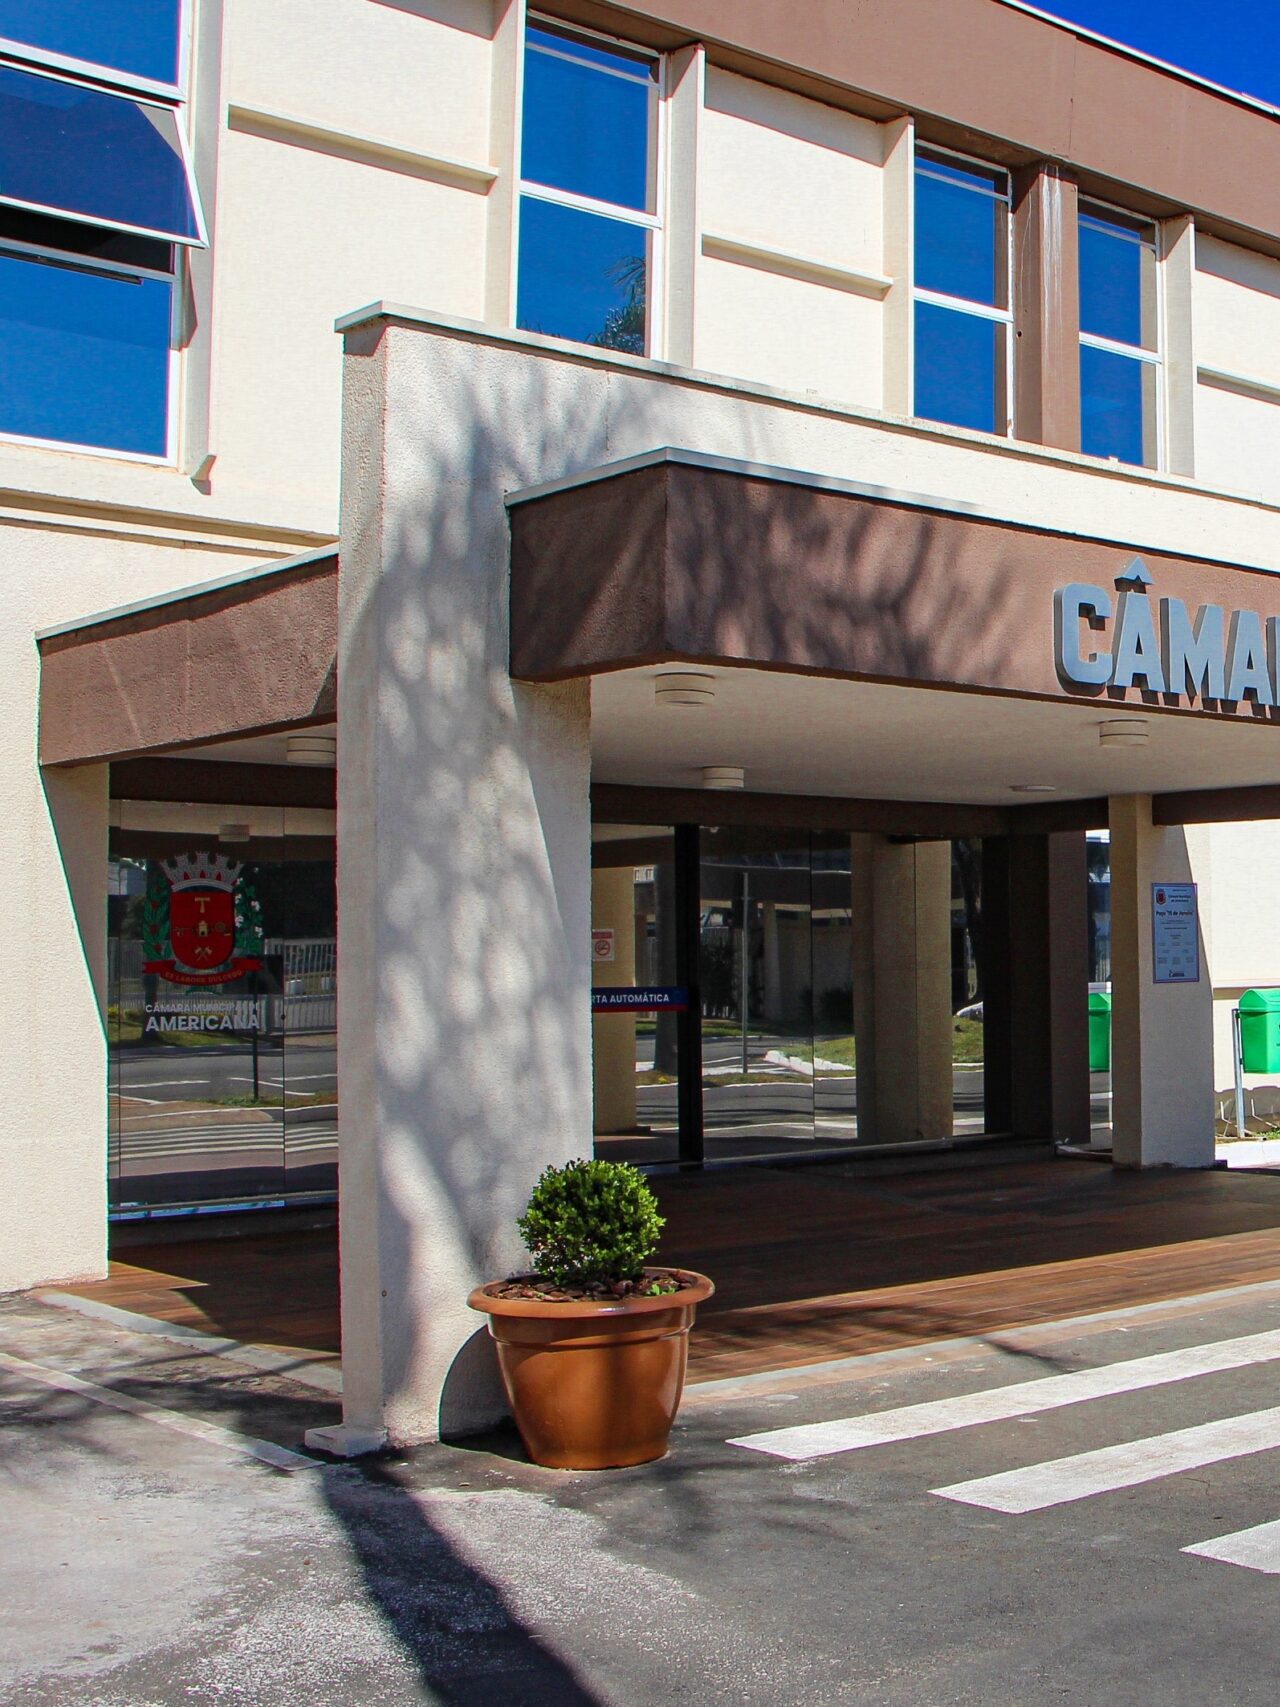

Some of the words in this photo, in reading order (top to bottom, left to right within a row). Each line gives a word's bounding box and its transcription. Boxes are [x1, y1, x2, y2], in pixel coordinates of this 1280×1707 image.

[591, 995, 608, 1004] RTA
[610, 992, 670, 1003] AUTOMÁTICA
[145, 1002, 191, 1013] CÂMARA
[145, 1015, 260, 1032] AMERICANA
